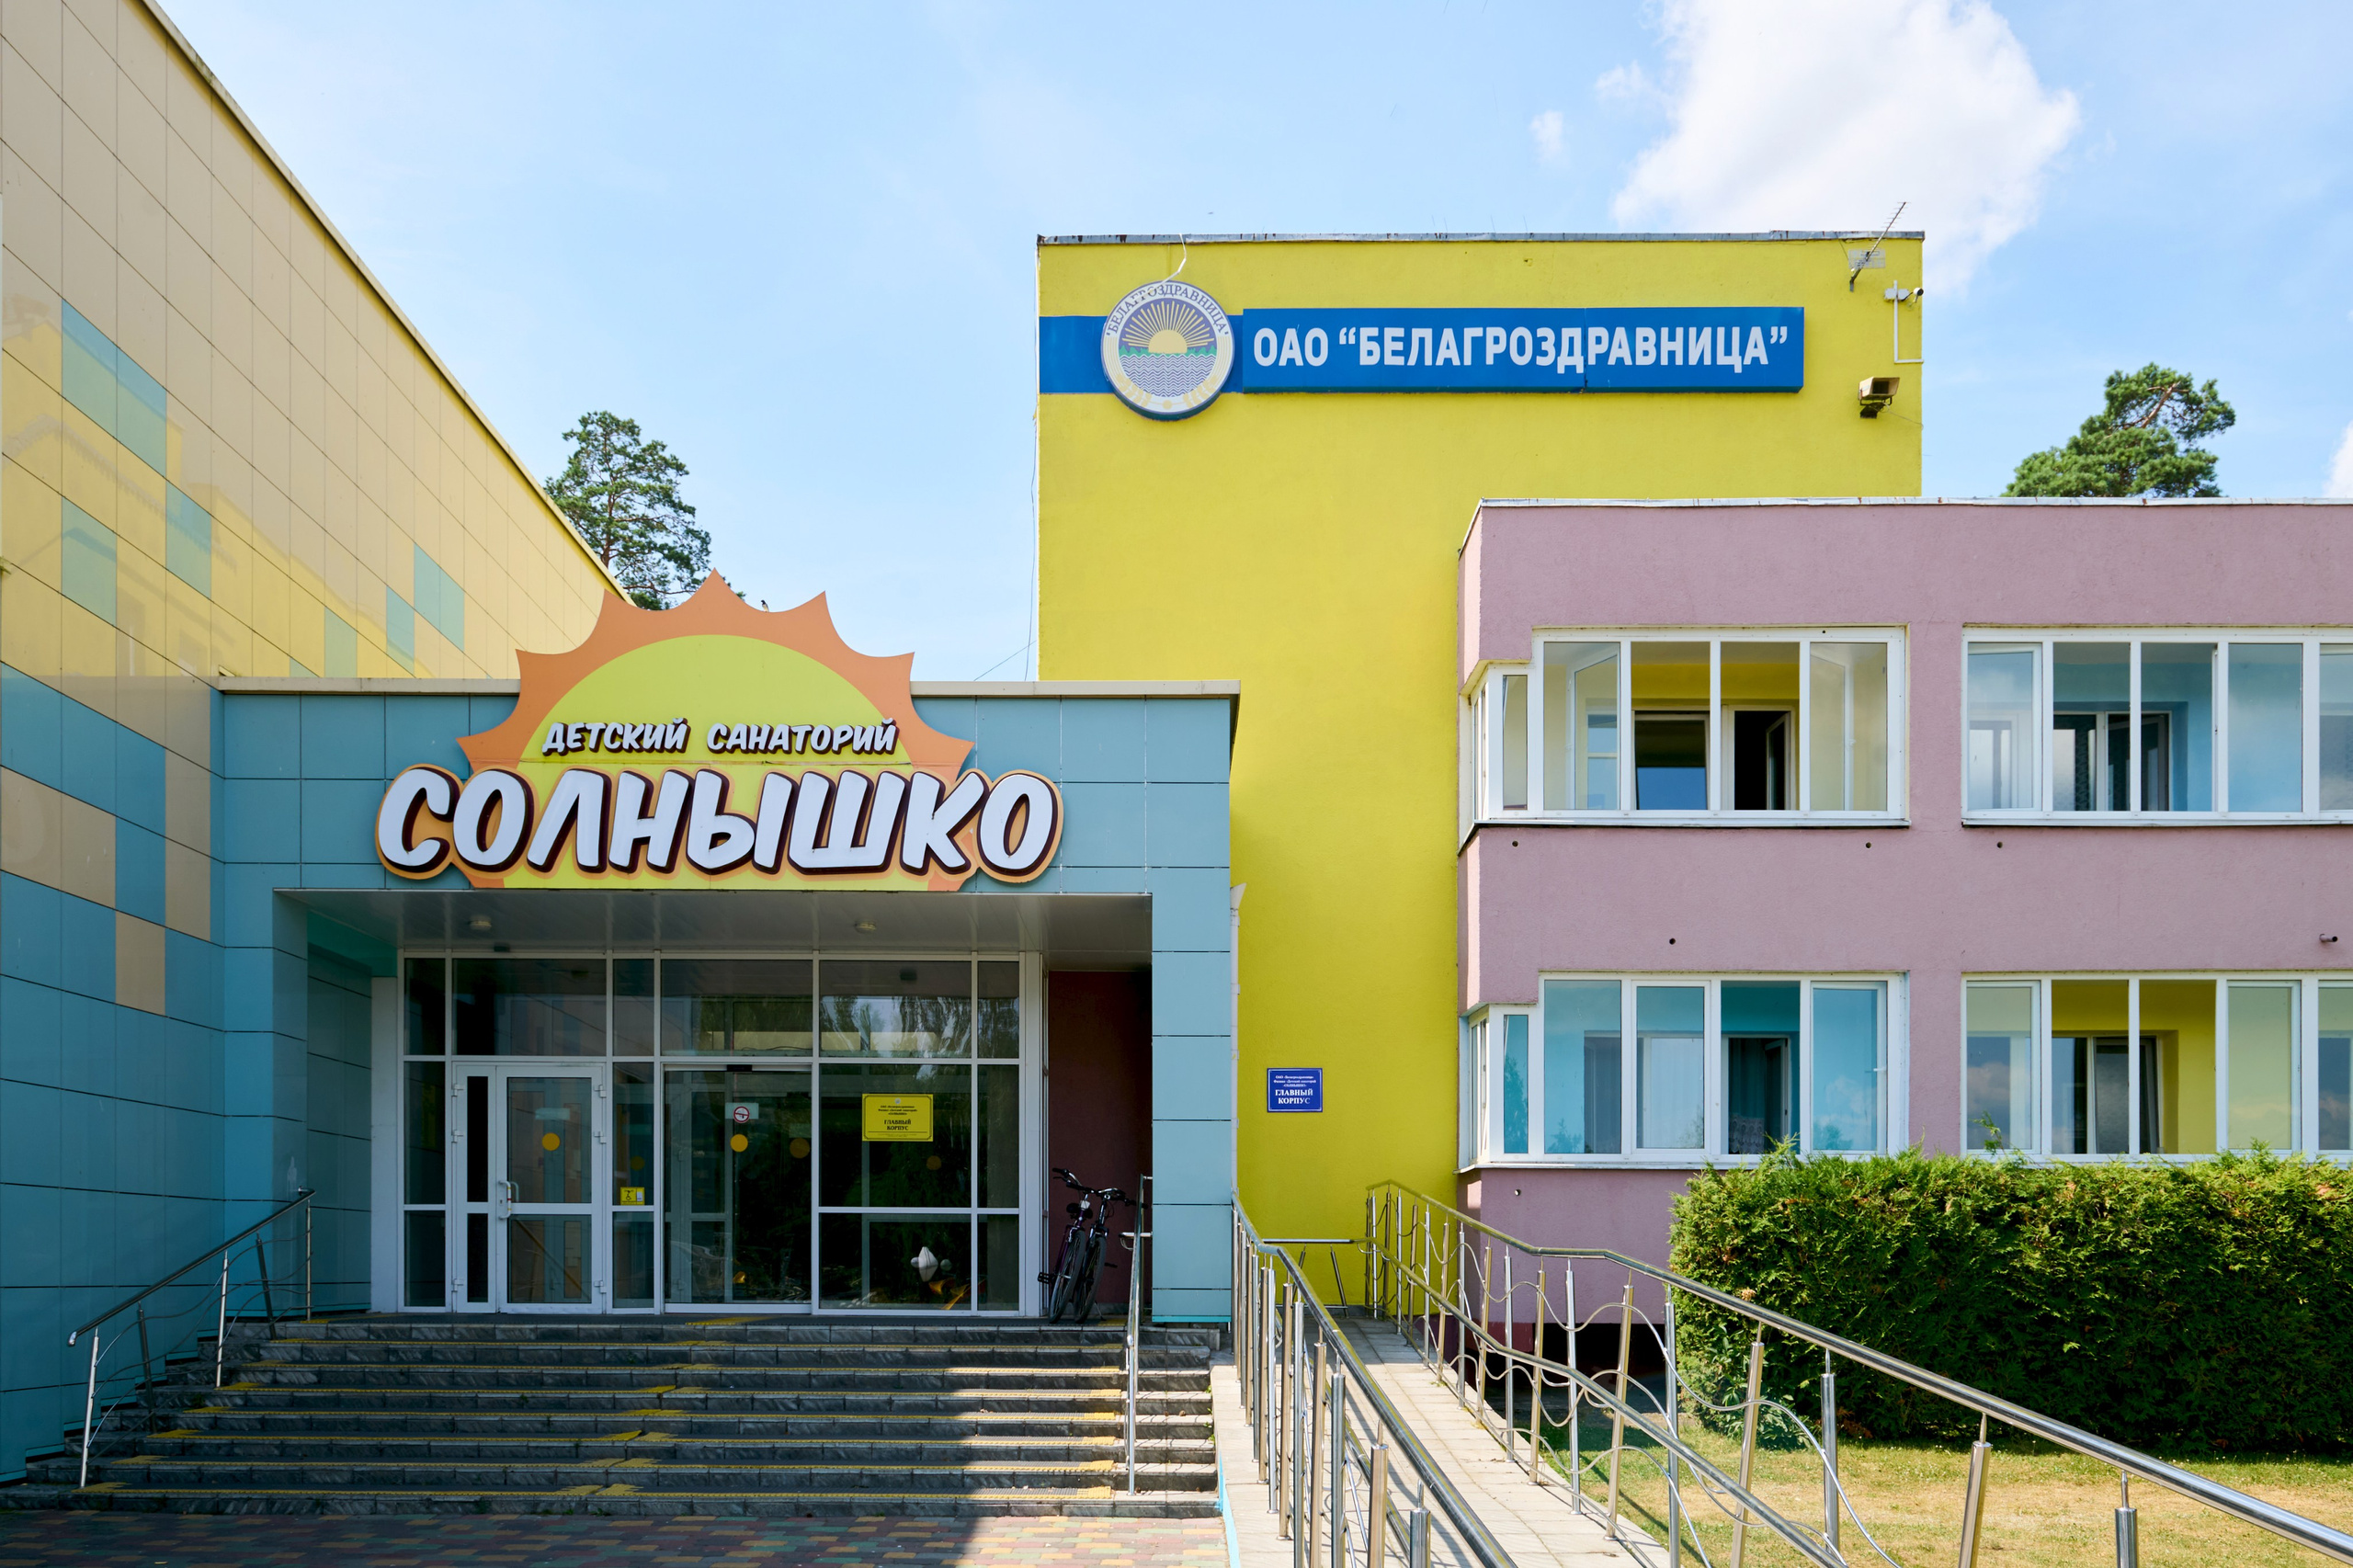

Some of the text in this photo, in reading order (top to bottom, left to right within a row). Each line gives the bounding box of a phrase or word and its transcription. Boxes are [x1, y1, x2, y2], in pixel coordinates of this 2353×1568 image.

[1253, 327, 1329, 367] ОАО
[541, 717, 900, 756] ДЕТСКИЙ САНАТОРИЙ
[378, 767, 1057, 875] СОЛНЫШКО
